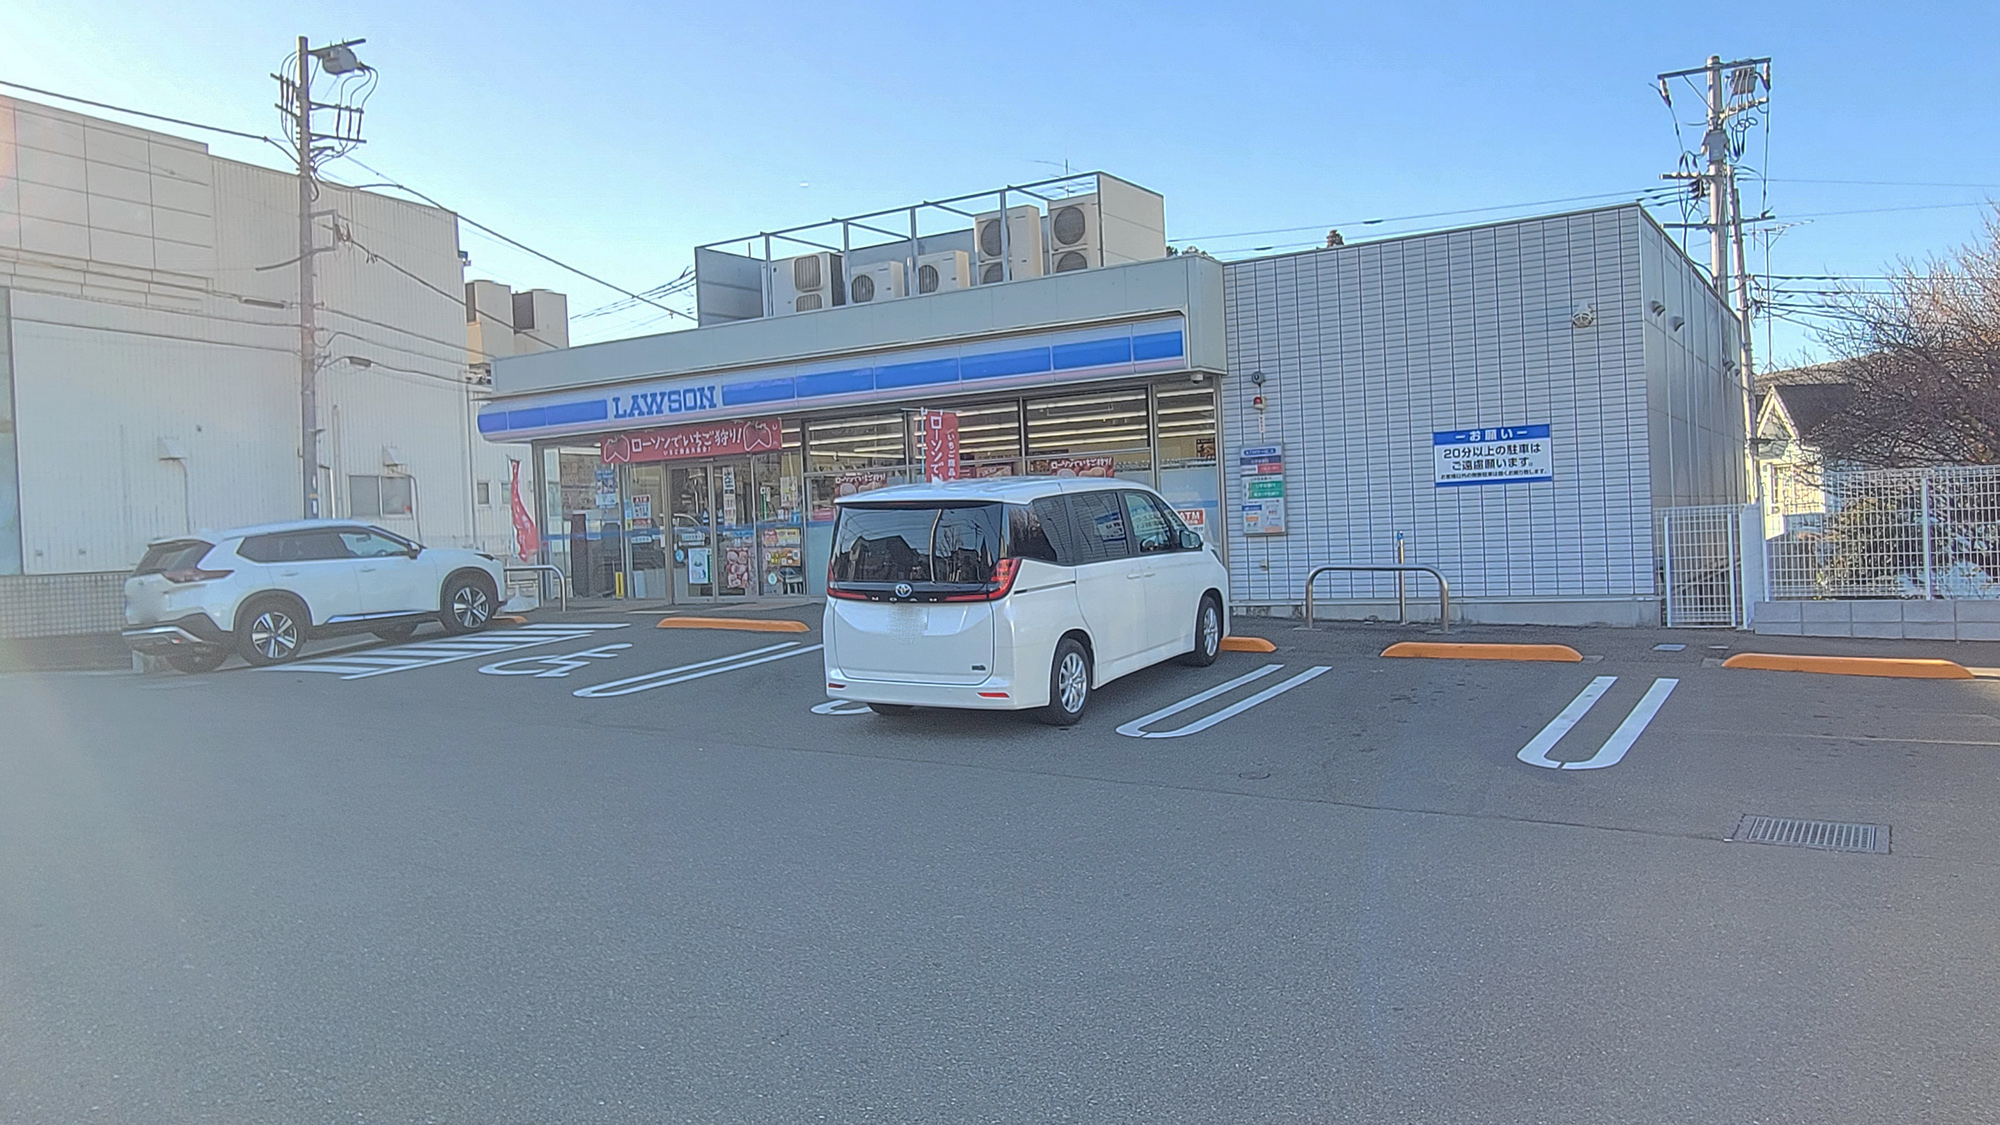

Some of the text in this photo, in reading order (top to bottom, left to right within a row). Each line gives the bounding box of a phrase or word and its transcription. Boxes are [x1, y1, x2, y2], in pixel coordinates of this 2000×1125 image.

[612, 386, 717, 419] LAWSON
[1443, 443, 1541, 459] 20分以上の駐車は
[1452, 457, 1533, 471] ご遠慮願います。
[1179, 511, 1200, 521] ATM
